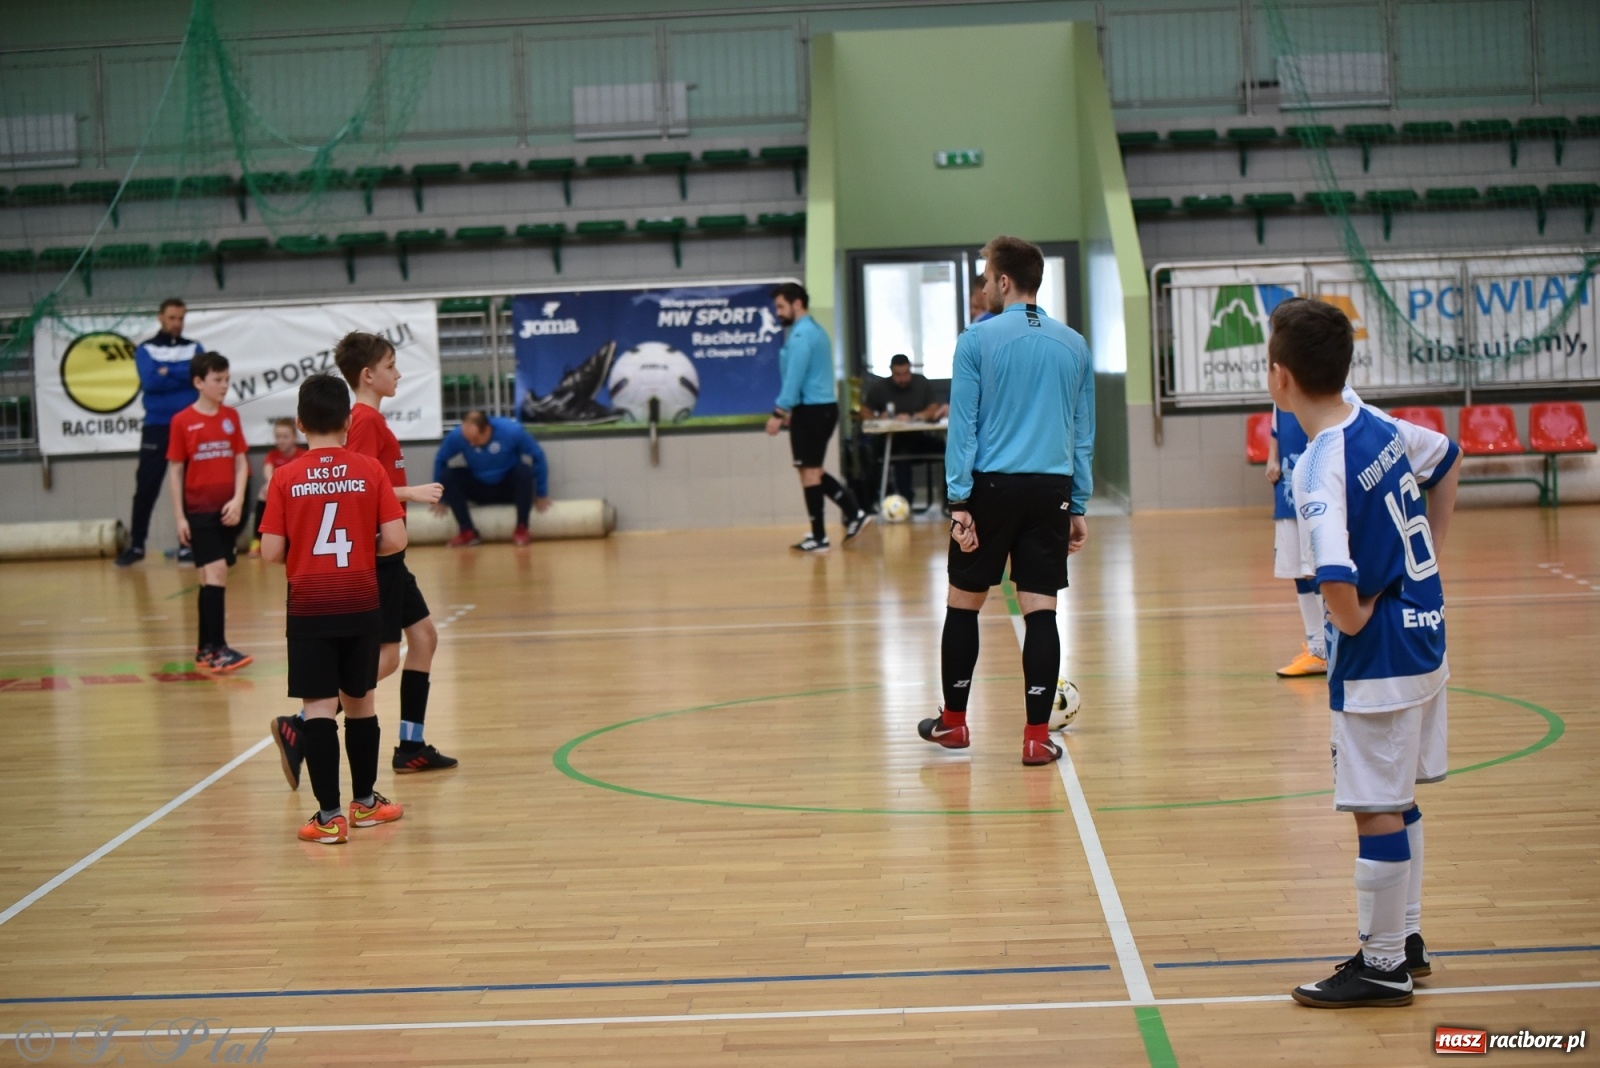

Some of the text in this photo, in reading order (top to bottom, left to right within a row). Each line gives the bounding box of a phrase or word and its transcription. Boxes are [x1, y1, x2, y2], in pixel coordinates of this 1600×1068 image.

[1409, 273, 1595, 321] POWIAT
[657, 306, 758, 328] MW SPORT
[691, 329, 758, 346] Racibórz
[1408, 331, 1588, 364] kibicujemy,
[232, 377, 257, 401] W
[62, 416, 143, 436] RACIBÓR
[307, 465, 347, 480] LKS 07
[291, 480, 366, 498] MARKOWICE
[312, 502, 353, 568] 4
[1384, 472, 1439, 582] 16
